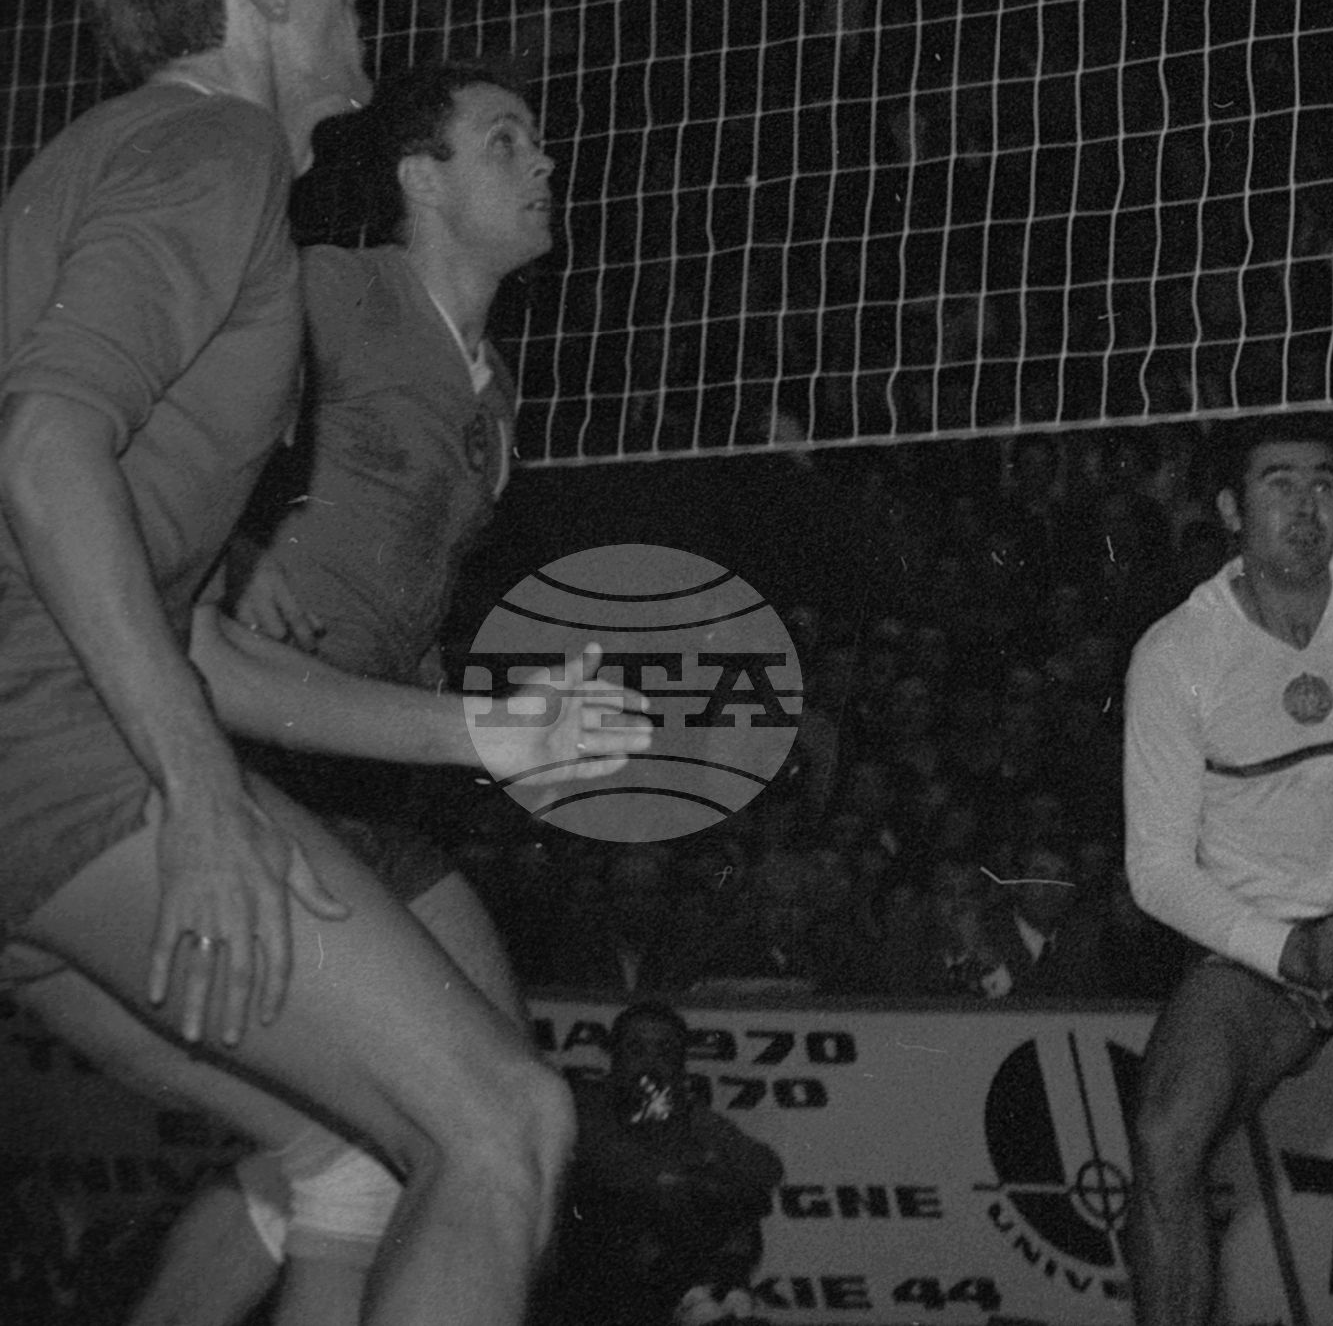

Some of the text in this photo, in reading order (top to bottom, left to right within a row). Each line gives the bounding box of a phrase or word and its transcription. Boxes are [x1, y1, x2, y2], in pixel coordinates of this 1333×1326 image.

[684, 1030, 858, 1065] 970
[779, 1184, 943, 1219] GNE
[751, 1275, 1002, 1312] KIE 44
